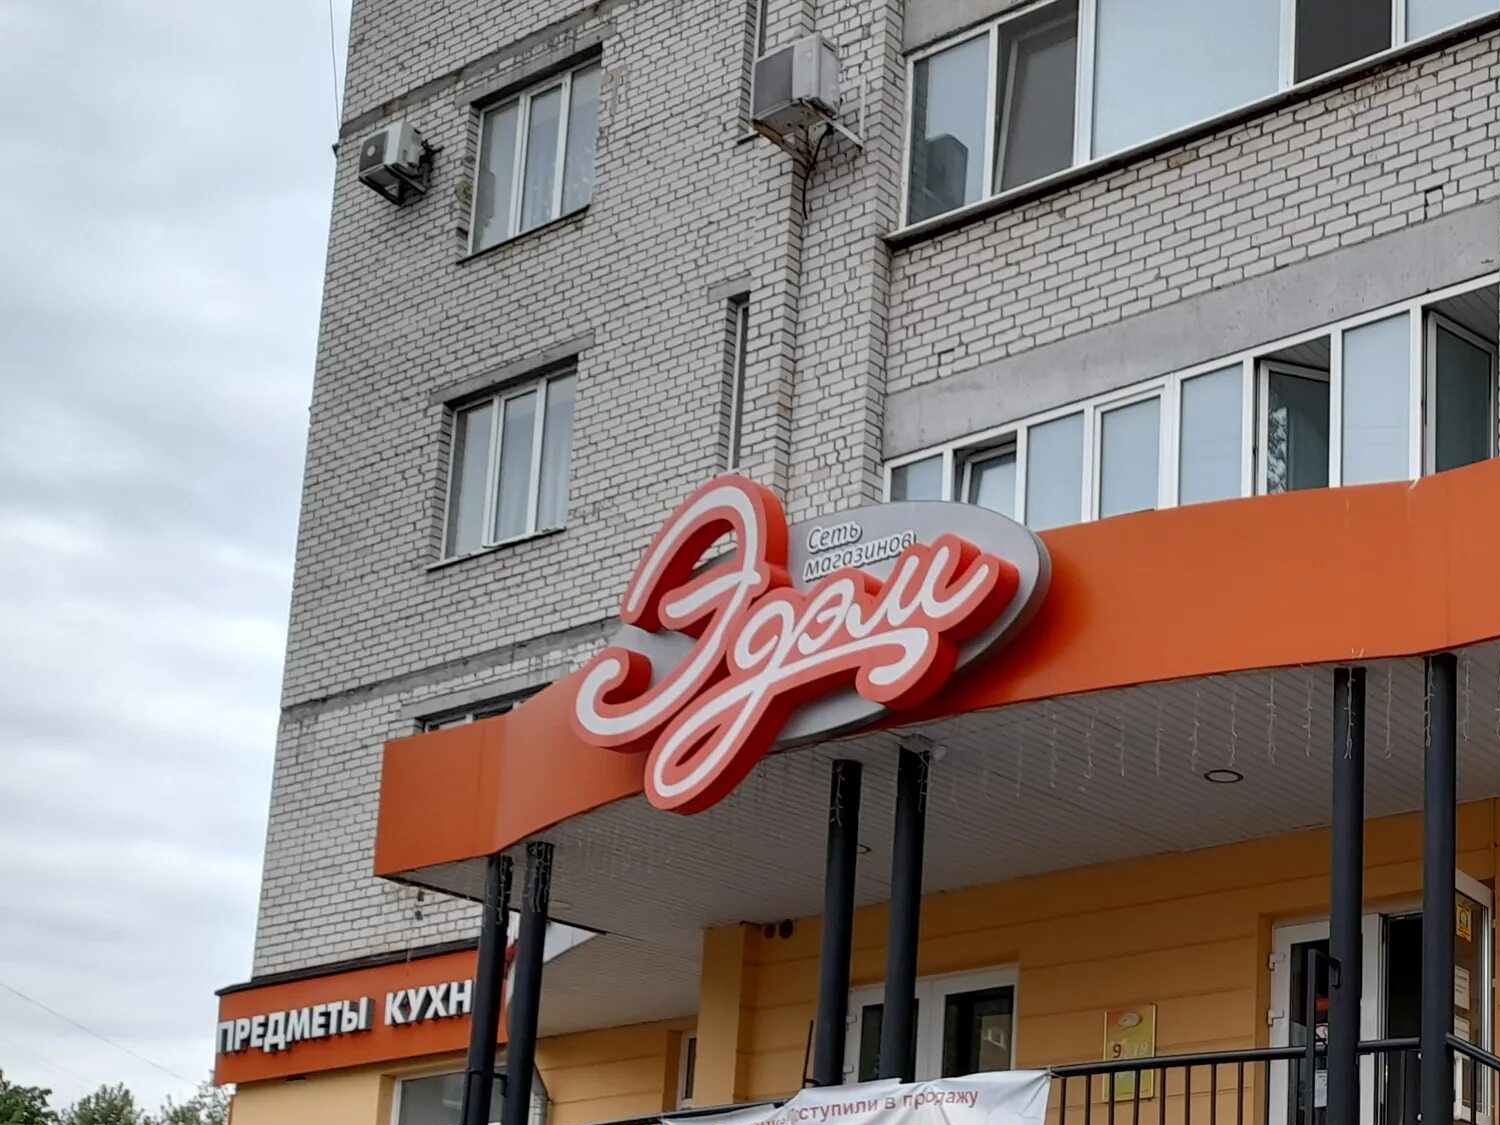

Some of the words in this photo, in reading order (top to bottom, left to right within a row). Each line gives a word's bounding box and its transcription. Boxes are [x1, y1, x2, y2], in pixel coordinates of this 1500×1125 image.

[805, 532, 913, 578] магазинов
[807, 523, 861, 551] Сеть
[216, 997, 369, 1052] ПРЕДМЕТЫ
[384, 979, 473, 1026] КУХН
[791, 1098, 877, 1123] оступили
[885, 1098, 896, 1110] в
[903, 1090, 978, 1110] продажу
